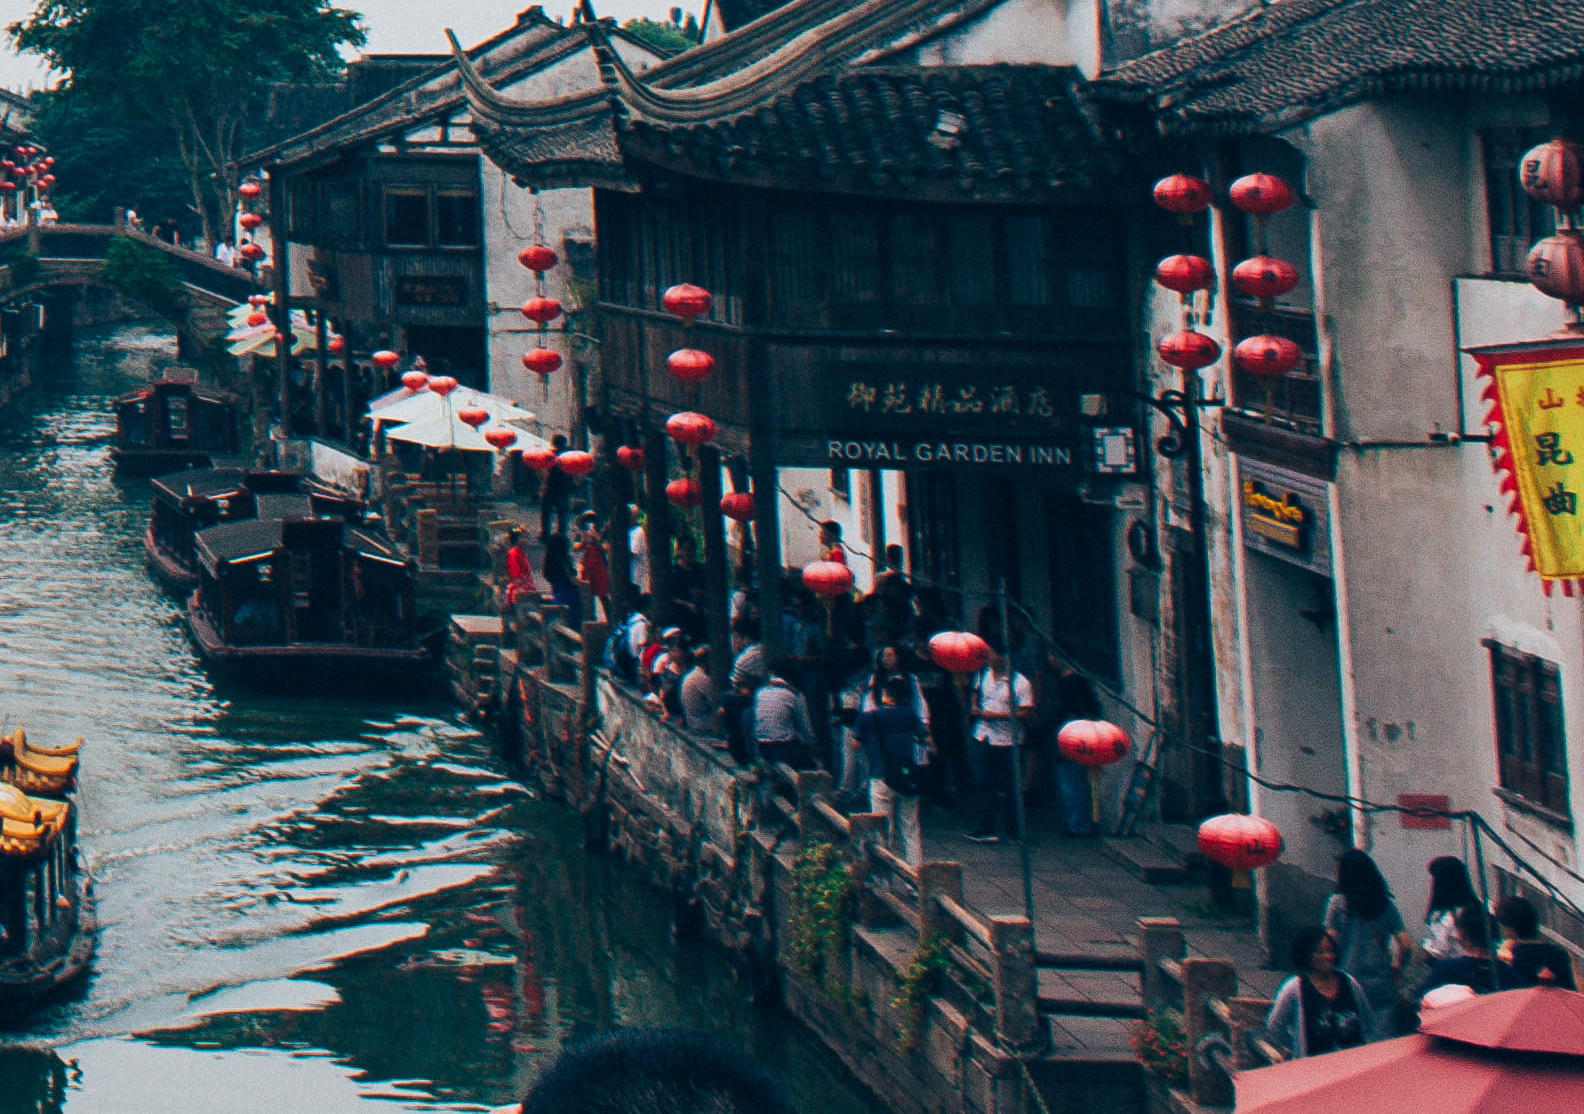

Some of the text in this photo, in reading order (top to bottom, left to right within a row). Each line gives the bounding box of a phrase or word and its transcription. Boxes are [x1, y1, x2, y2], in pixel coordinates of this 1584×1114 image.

[827, 439, 1072, 466] ROYAL GARDEN INN
[1535, 432, 1578, 516] 昆曲
